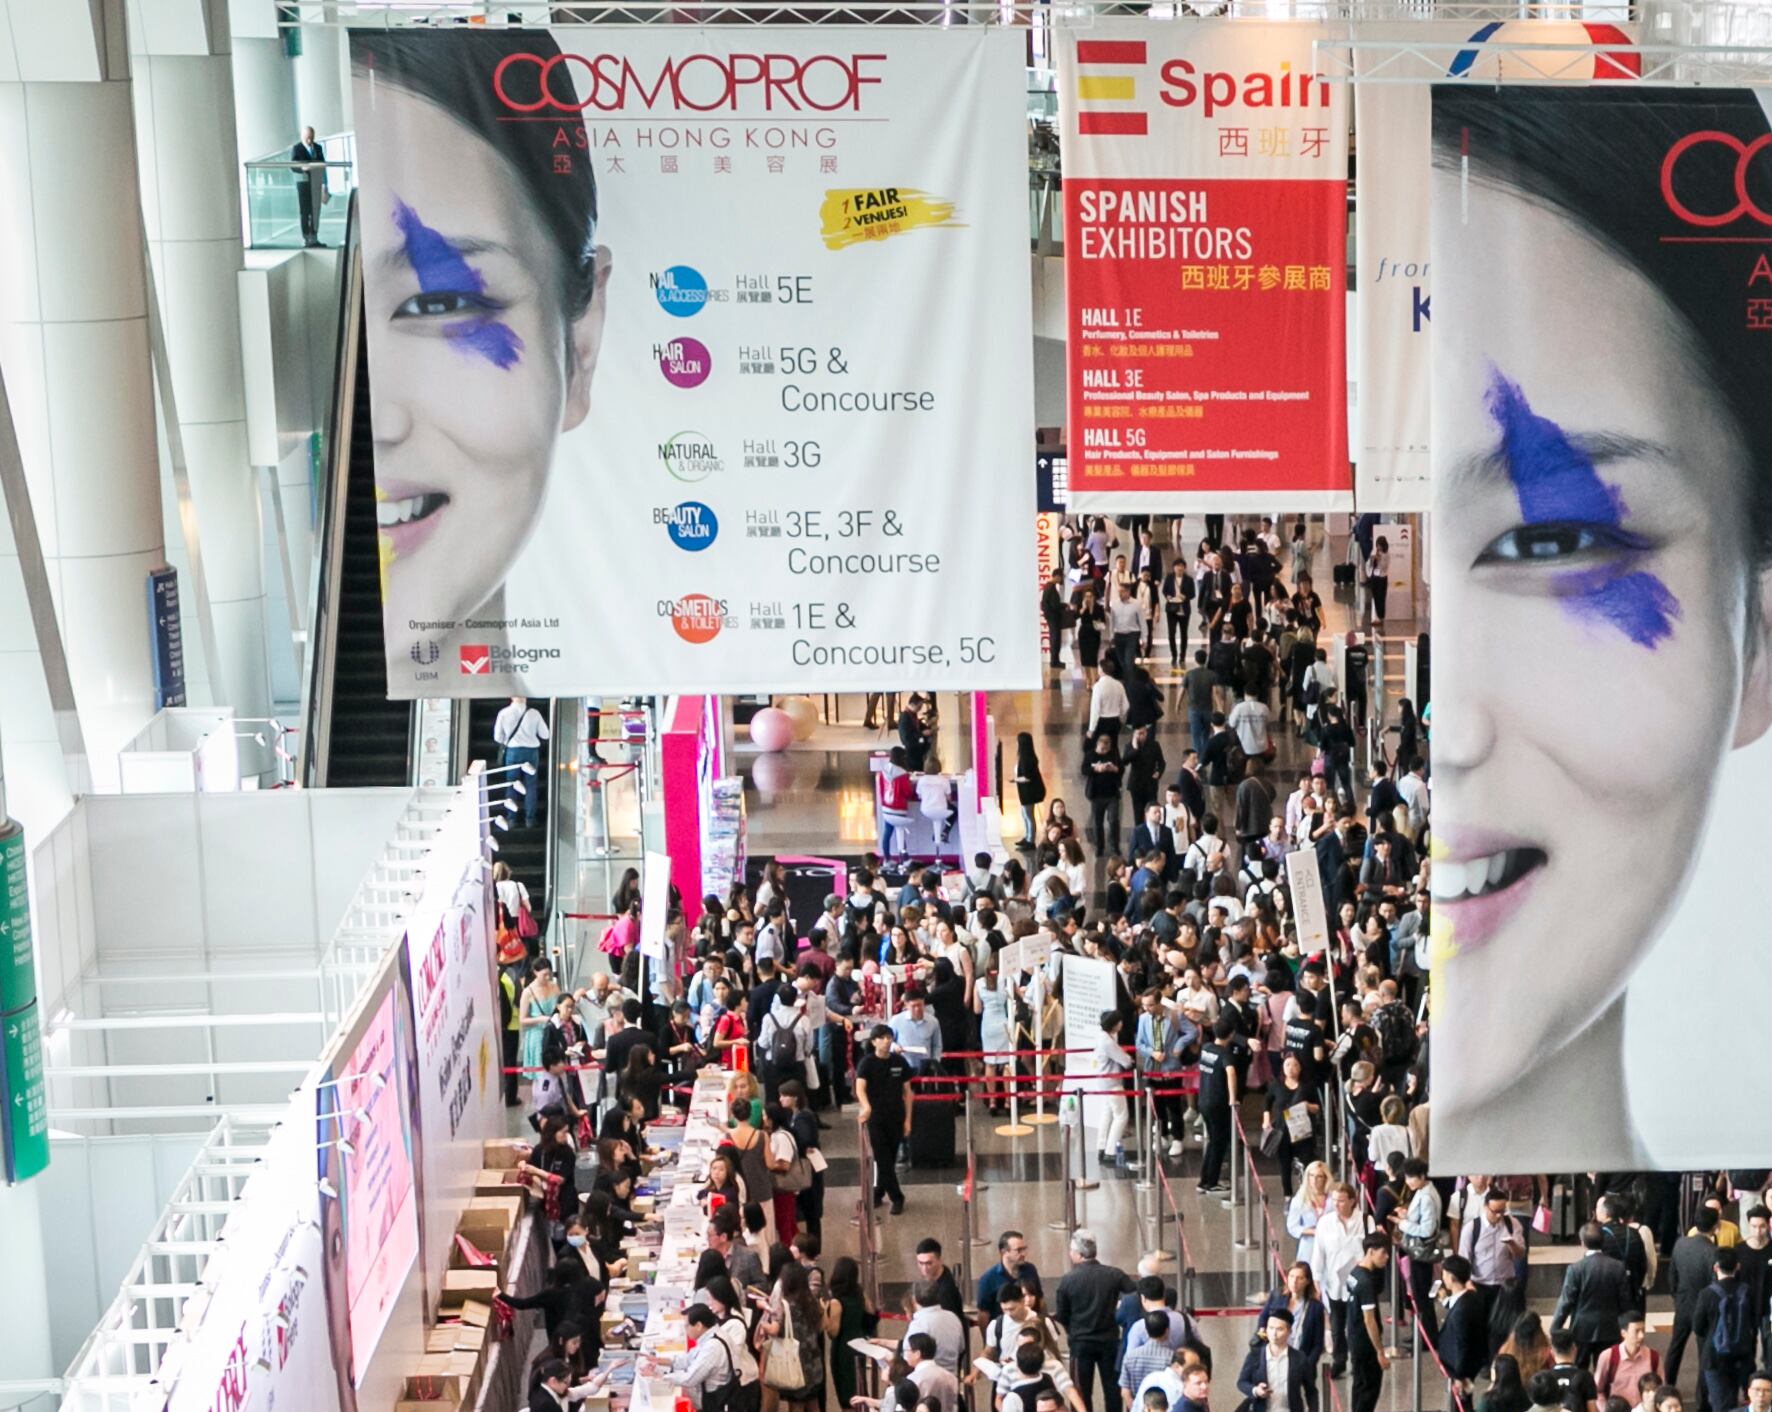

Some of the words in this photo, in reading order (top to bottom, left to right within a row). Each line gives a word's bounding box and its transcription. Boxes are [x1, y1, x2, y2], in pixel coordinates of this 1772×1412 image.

[493, 52, 887, 112] COSMOPROF
[1159, 57, 1331, 118] Spain
[553, 127, 621, 149] ASIA
[637, 127, 731, 149] HONG
[746, 127, 837, 148] KONG
[1218, 126, 1331, 159] 西班牙
[553, 155, 838, 174] 亞太區美容展
[853, 187, 902, 212] FAIR
[1080, 190, 1207, 223] SPANISH
[853, 206, 908, 227] VENUES!
[1081, 227, 1252, 260] EXHIBITORS
[649, 272, 678, 289] NAIL
[1181, 264, 1332, 290] 西班牙參展商
[668, 289, 730, 301] ACCESSORIES
[736, 275, 769, 289] Hall
[777, 276, 813, 304] 5E
[1082, 309, 1119, 327] HALL
[1124, 308, 1142, 326] 1E
[1082, 330, 1127, 340] Perfumery,
[1129, 330, 1171, 339] Cosmetics
[1182, 330, 1219, 340] Toiletries
[653, 343, 683, 361] HAIR
[739, 346, 772, 360] Hall
[780, 347, 817, 375] 5G
[827, 347, 849, 374] &
[669, 360, 701, 374] SALON
[1083, 370, 1120, 387] HALL
[1124, 369, 1143, 387] 3E
[781, 384, 935, 412] Concourse
[1083, 391, 1134, 401] Professional
[1136, 391, 1164, 401] Beauty
[1193, 391, 1209, 401] Spa
[1211, 391, 1247, 400] Products
[1249, 391, 1264, 400] and
[1266, 391, 1310, 401] Equipment
[1084, 429, 1121, 446] HALL
[1125, 428, 1146, 446] 5G
[658, 443, 718, 460] NATURAL
[743, 440, 776, 454] Hall
[783, 440, 821, 468] 3G
[1084, 450, 1101, 459] Hair
[1144, 450, 1188, 460] Equipment
[1189, 450, 1205, 459] and
[1206, 450, 1229, 459] Salon
[1230, 450, 1279, 460] Furnishings
[687, 460, 724, 472] ORGANIC
[653, 507, 702, 525] BEAUTY
[745, 510, 779, 524] Hall
[786, 510, 829, 541] 3E,
[837, 510, 874, 538] 3F
[882, 509, 904, 537] &
[678, 525, 710, 537] SALON
[788, 547, 941, 575] Concourse
[657, 599, 728, 617] COSMETICS
[749, 601, 783, 616] Hall
[793, 602, 826, 630] 1E
[835, 602, 857, 629] &
[408, 619, 455, 631] Organiser
[465, 619, 518, 630] Cosmoprof
[521, 618, 541, 628] Asia
[544, 618, 559, 628] Ltd
[690, 616, 739, 630] TOILETRIES
[490, 645, 560, 662] Bologna
[792, 639, 951, 667] Concourse,
[959, 636, 996, 664] 5C
[491, 660, 529, 673] Fiere
[415, 672, 438, 681] UBM
